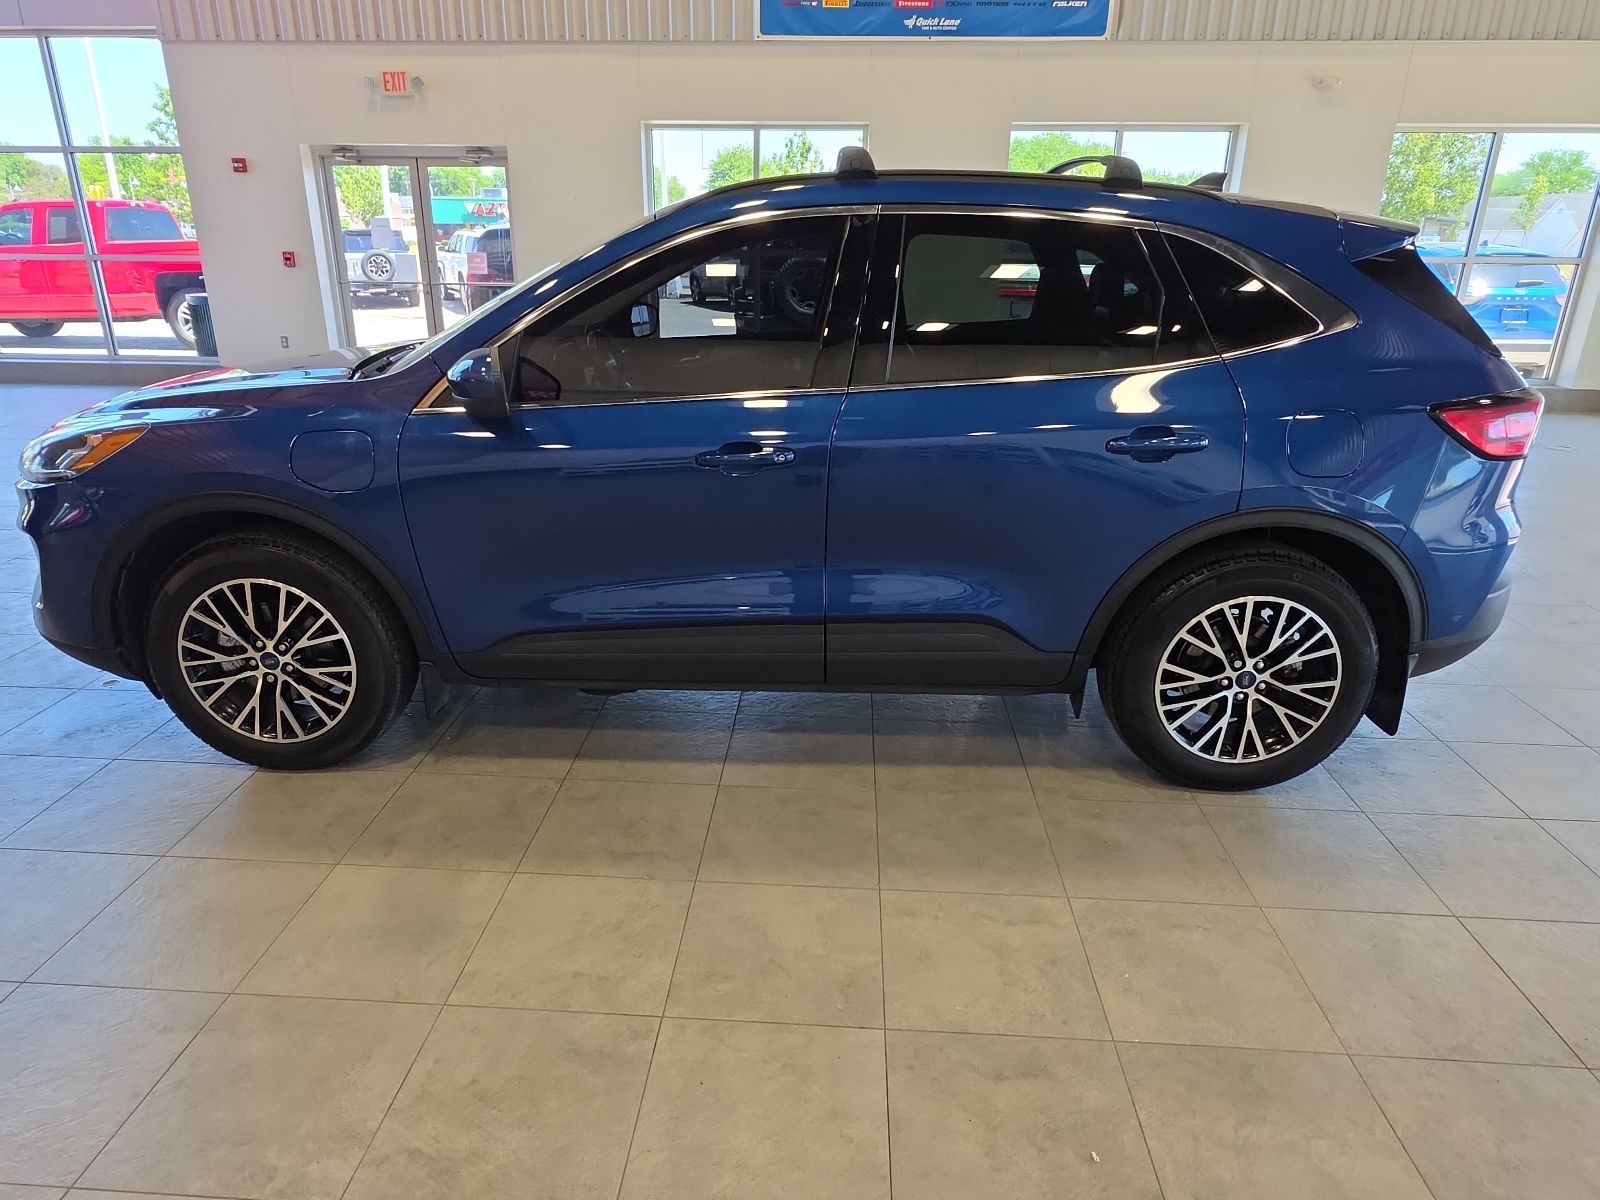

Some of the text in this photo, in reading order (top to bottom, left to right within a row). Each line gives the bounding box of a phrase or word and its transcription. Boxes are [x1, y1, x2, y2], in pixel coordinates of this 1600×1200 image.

[915, 17, 960, 27] Quick Lane
[382, 71, 406, 92] EXIT
